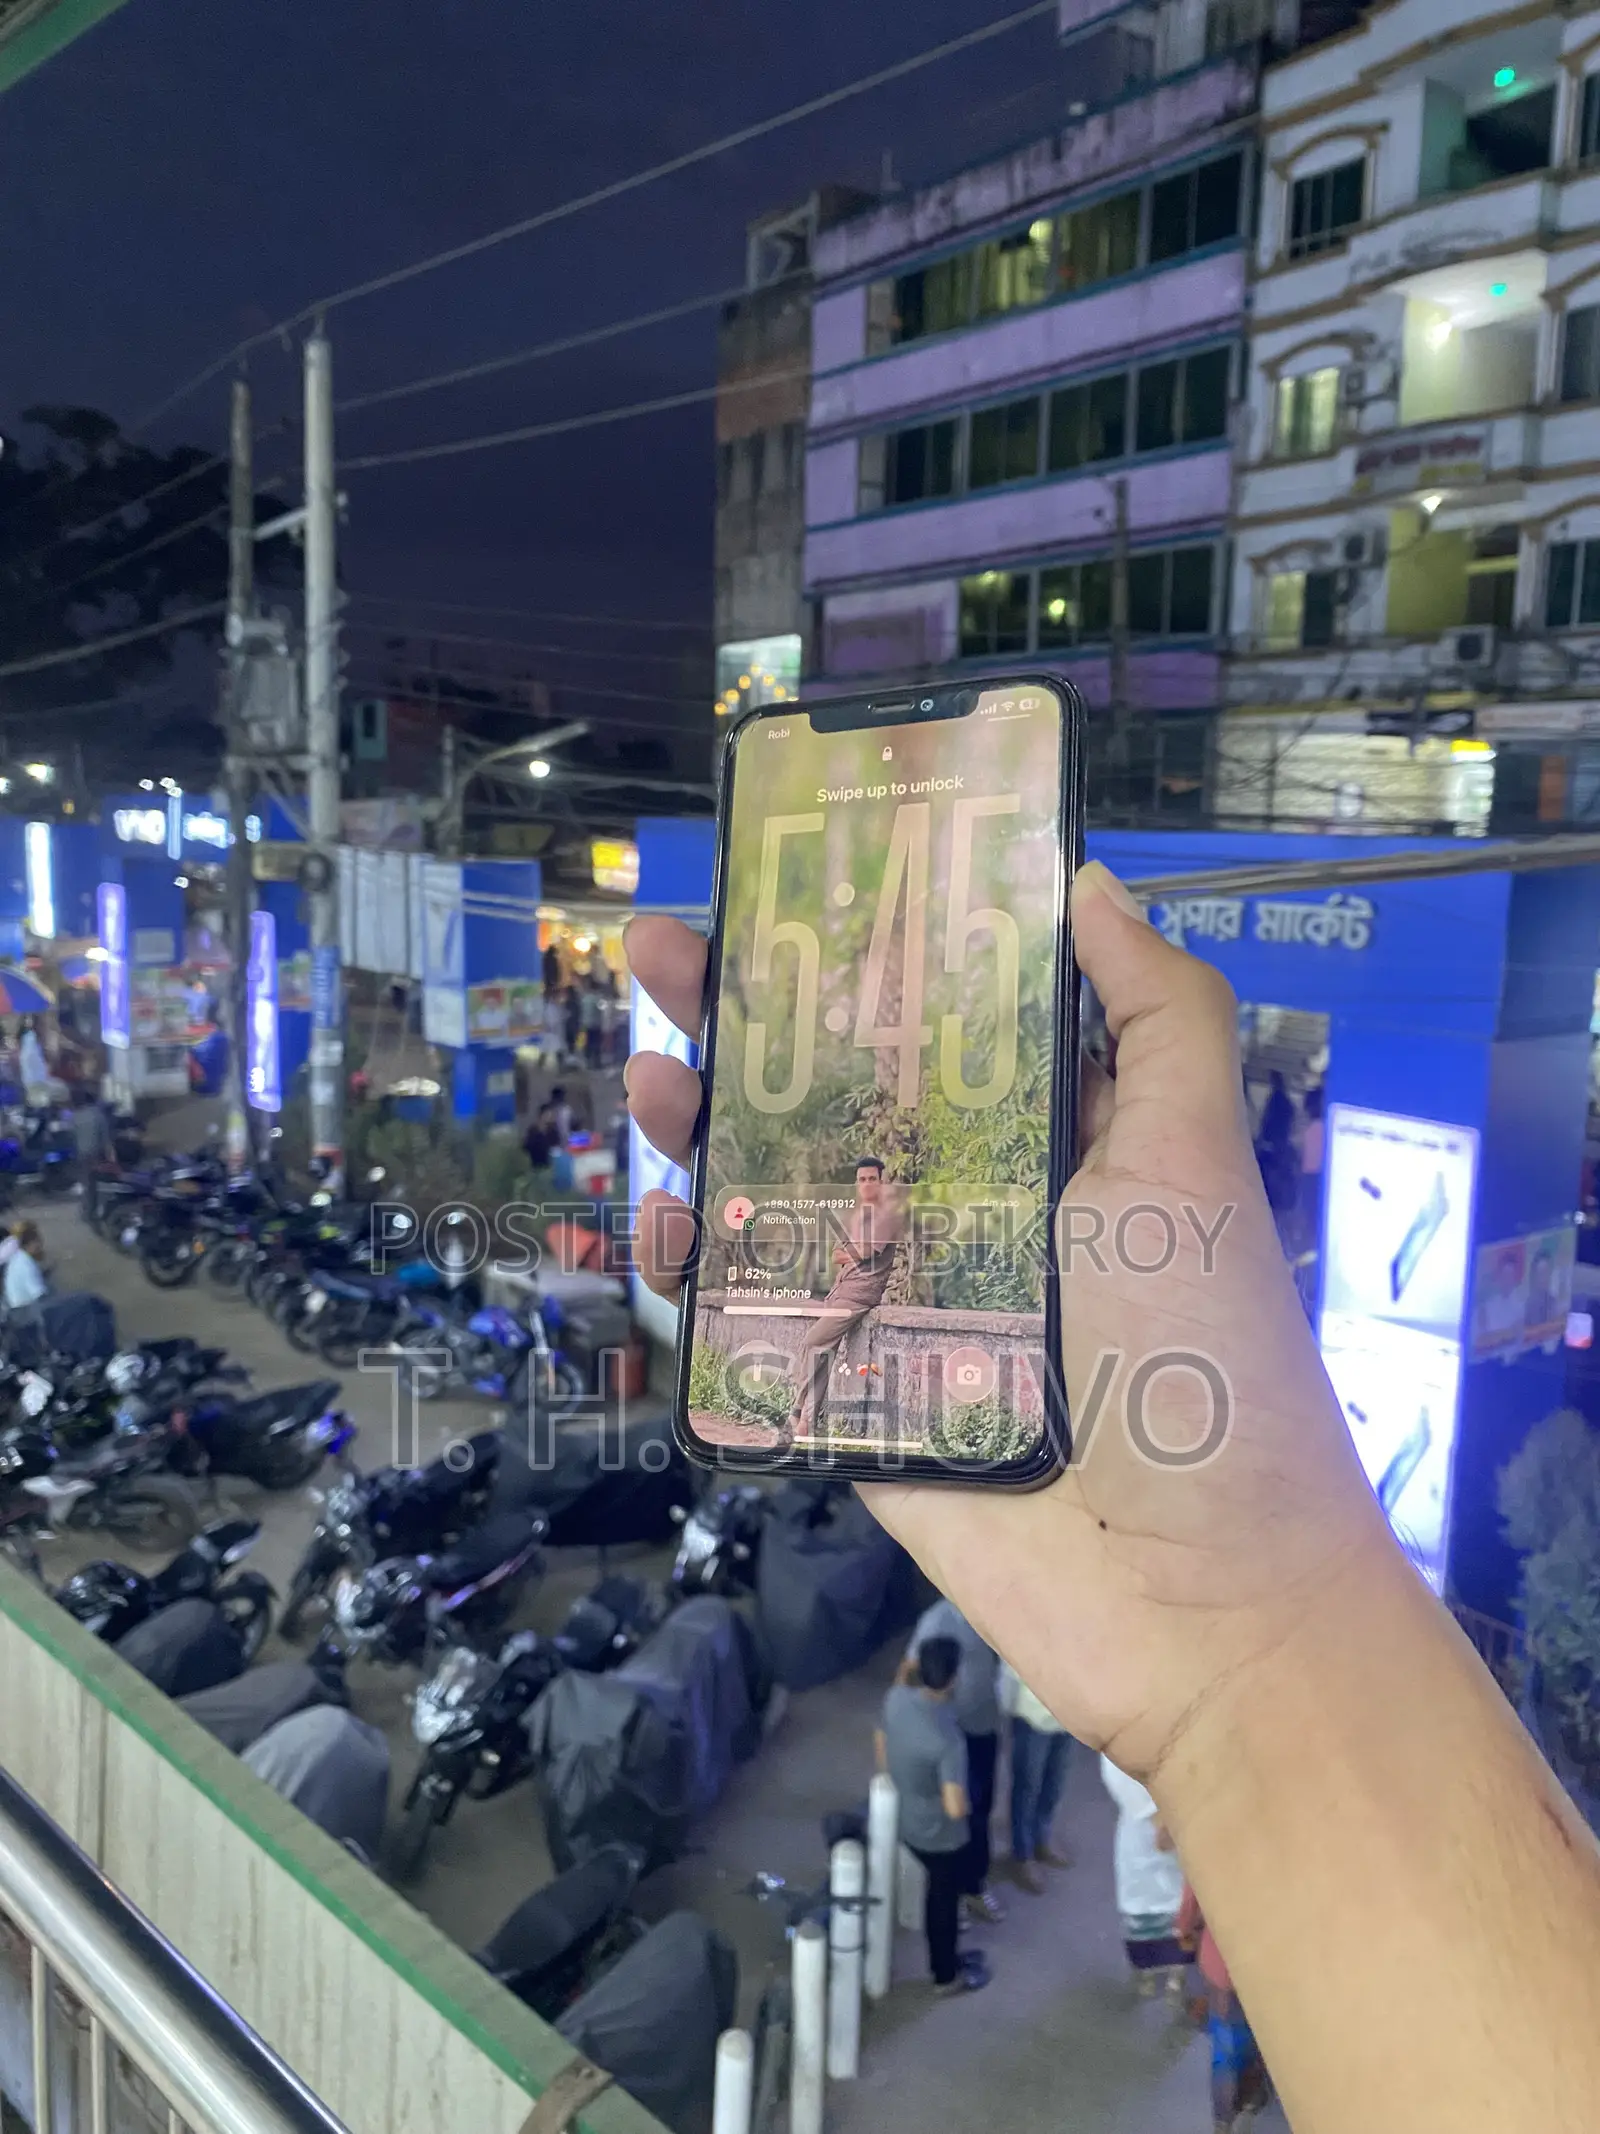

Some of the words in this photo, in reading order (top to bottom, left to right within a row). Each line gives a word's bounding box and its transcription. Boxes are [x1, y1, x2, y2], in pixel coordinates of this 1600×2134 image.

[768, 728, 791, 740] Robi
[816, 785, 864, 803] Swipe
[867, 783, 888, 800] up
[891, 781, 907, 795] to
[910, 775, 964, 794] unlock
[1255, 891, 1374, 949] মার্কেট
[744, 794, 1020, 1114] 5:45
[763, 1215, 816, 1225] Notification
[745, 1268, 772, 1280] 62%
[725, 1286, 770, 1299] Tahsin's
